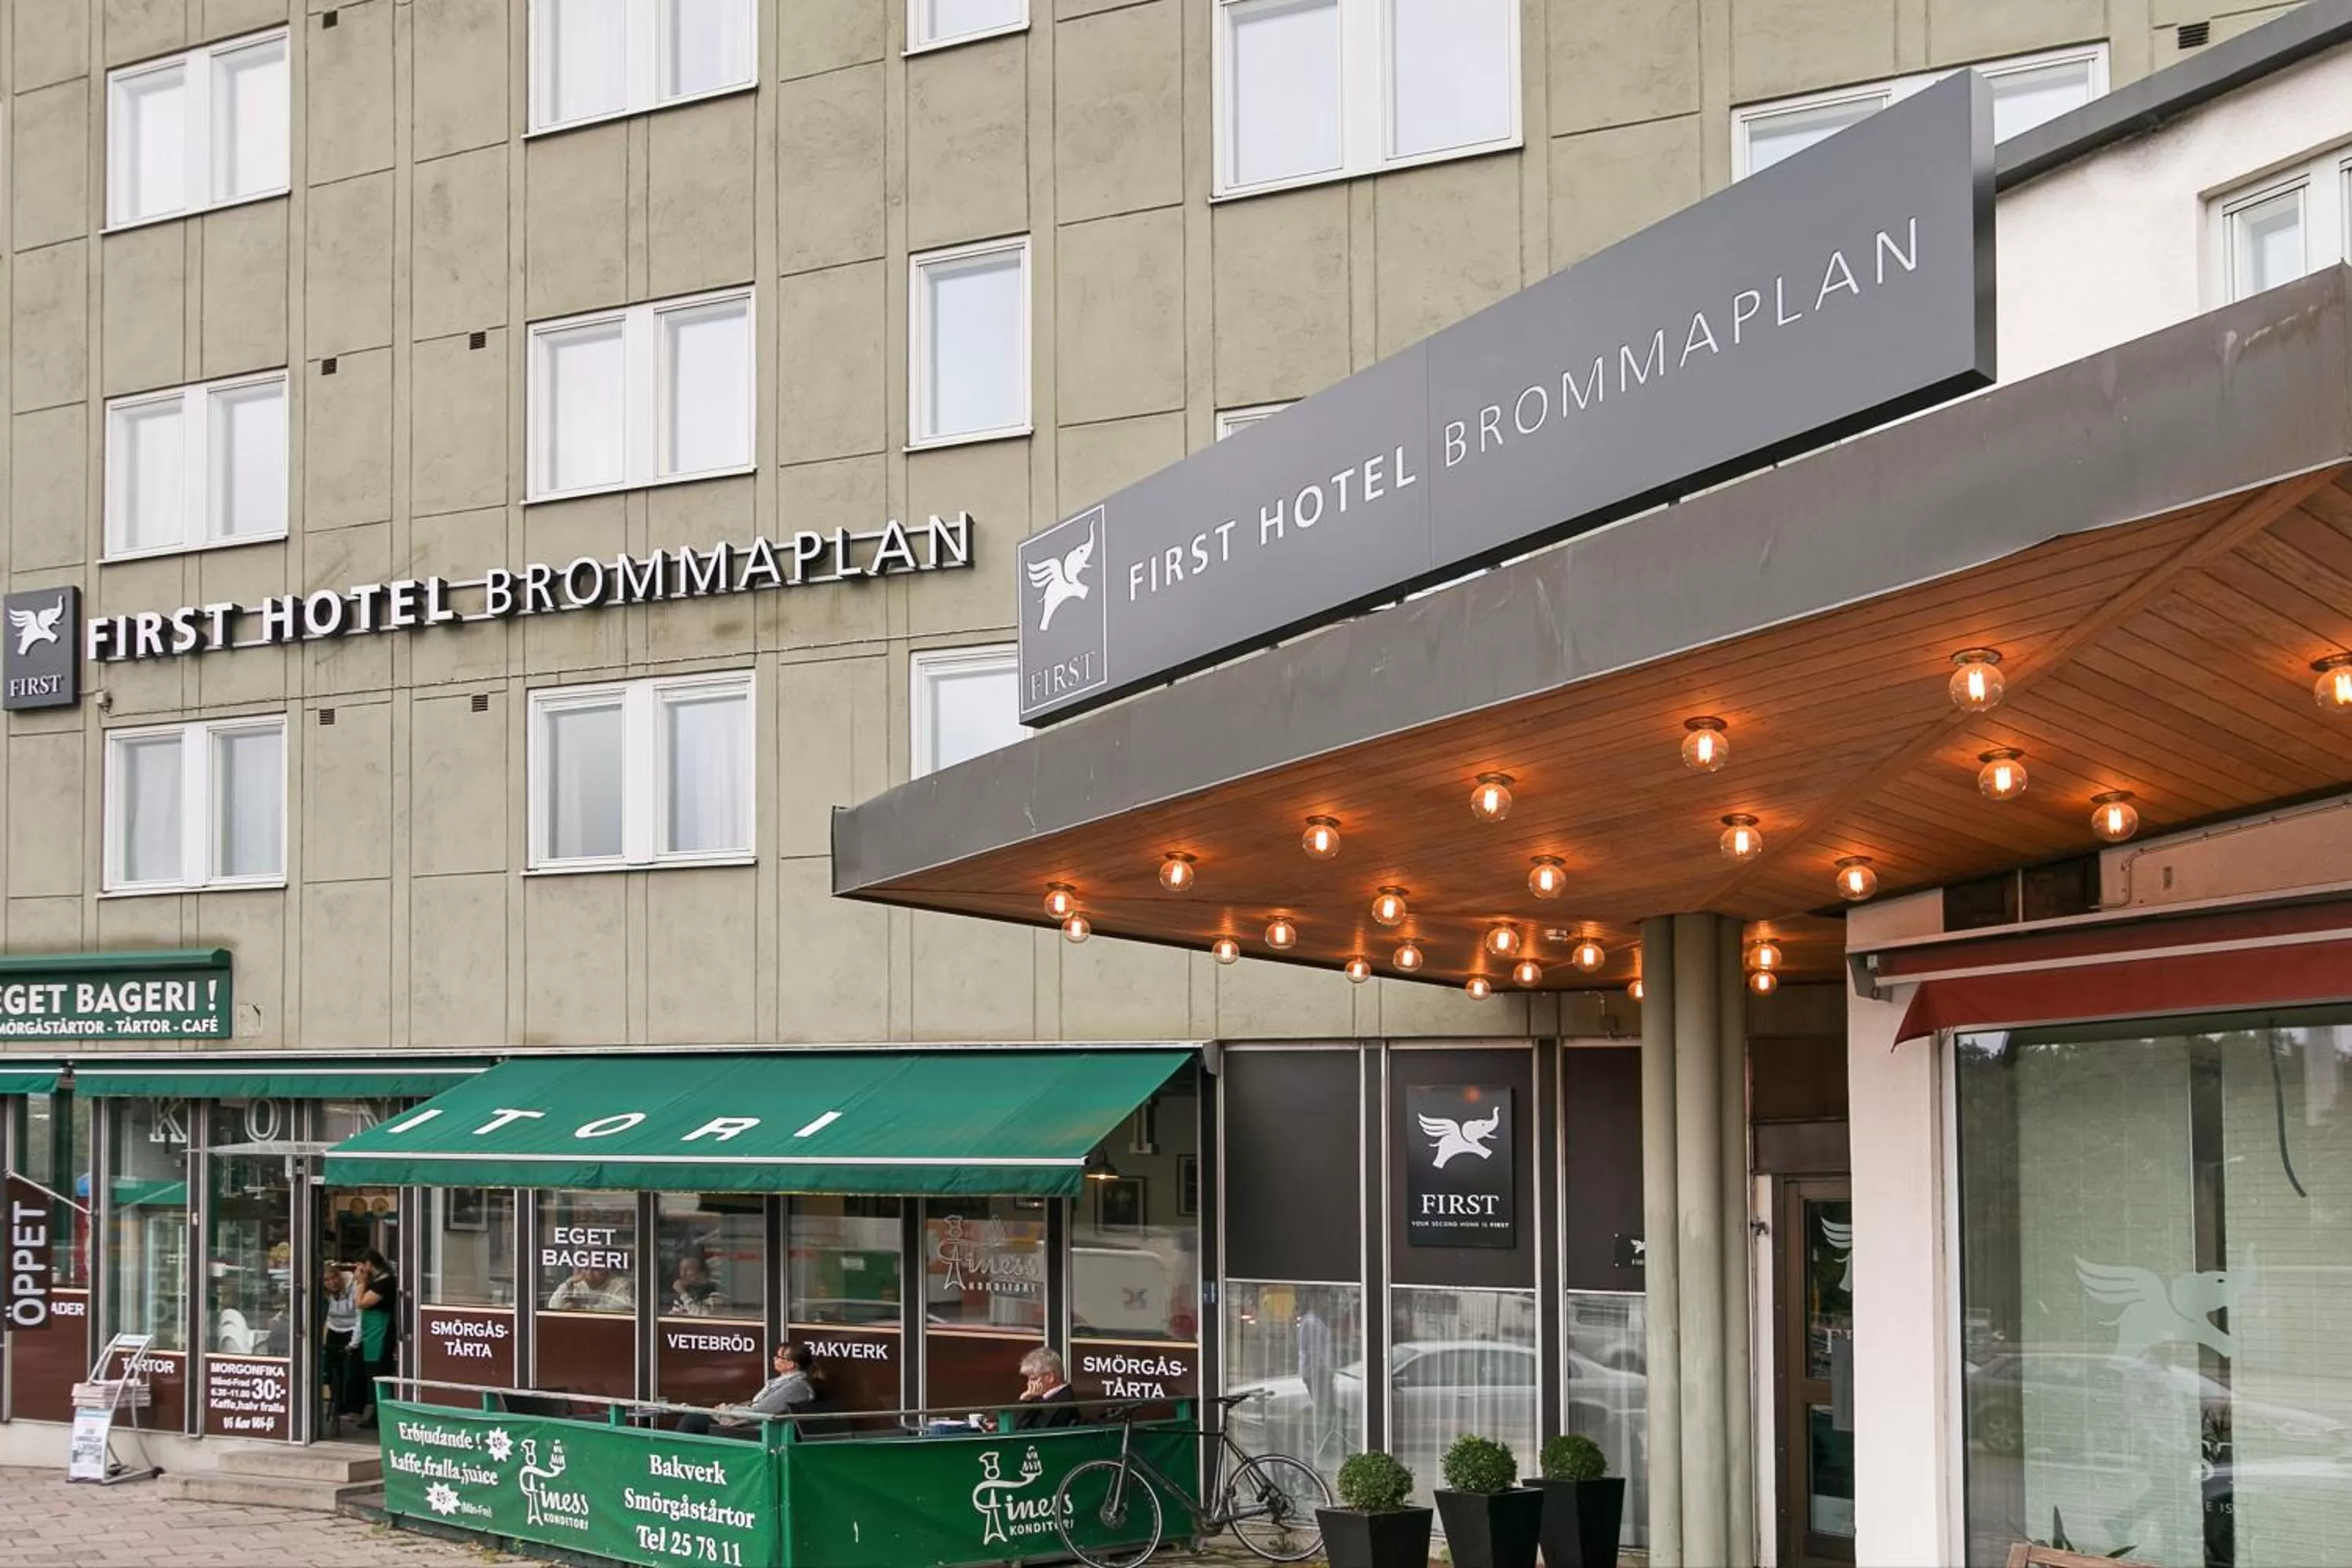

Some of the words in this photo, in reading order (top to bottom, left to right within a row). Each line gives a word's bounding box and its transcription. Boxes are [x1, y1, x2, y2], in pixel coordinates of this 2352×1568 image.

[1130, 521, 1236, 601] FIRST
[1260, 445, 1416, 545] HOTEL
[1445, 217, 1917, 468] BROMMAPLAN
[88, 602, 239, 660] FIRST
[263, 576, 456, 642] HOTEL
[486, 511, 971, 616] BROMMAPLAN
[10, 674, 61, 697] FIRST
[1031, 652, 1094, 701] FIRST
[0, 984, 67, 1014] GET
[77, 982, 195, 1013] BAGERI
[0, 1017, 104, 1034] MÖRGÅSTÅRTOR
[116, 1016, 170, 1033] TÅRTOR
[182, 1015, 218, 1033] CAFÉ
[1421, 1194, 1499, 1214] FIRST
[554, 1227, 616, 1245] EGET
[5, 1200, 46, 1326] ÖPPET
[542, 1249, 628, 1269] BAGERI
[51, 1301, 85, 1316] ADER
[430, 1319, 508, 1340] SMÖRGÅS-
[445, 1340, 493, 1359] TÅRTA
[667, 1333, 755, 1353] VETEBRÖD
[210, 1363, 285, 1377] MORGONFIKA
[1083, 1354, 1188, 1376] SMÖRGÅS-
[252, 1378, 286, 1400] 30:-
[1102, 1377, 1166, 1398] TÅRTA
[397, 1422, 474, 1449] Erbjudande
[649, 1454, 727, 1485] Bakverk
[625, 1488, 755, 1529] Smörgåstårtor
[543, 1512, 589, 1530] KONDITORI
[1009, 1519, 1074, 1536] KONDITRI
[636, 1525, 665, 1552] Tel
[671, 1530, 692, 1556] 25
[696, 1536, 717, 1562] 78
[722, 1541, 742, 1567] 11
